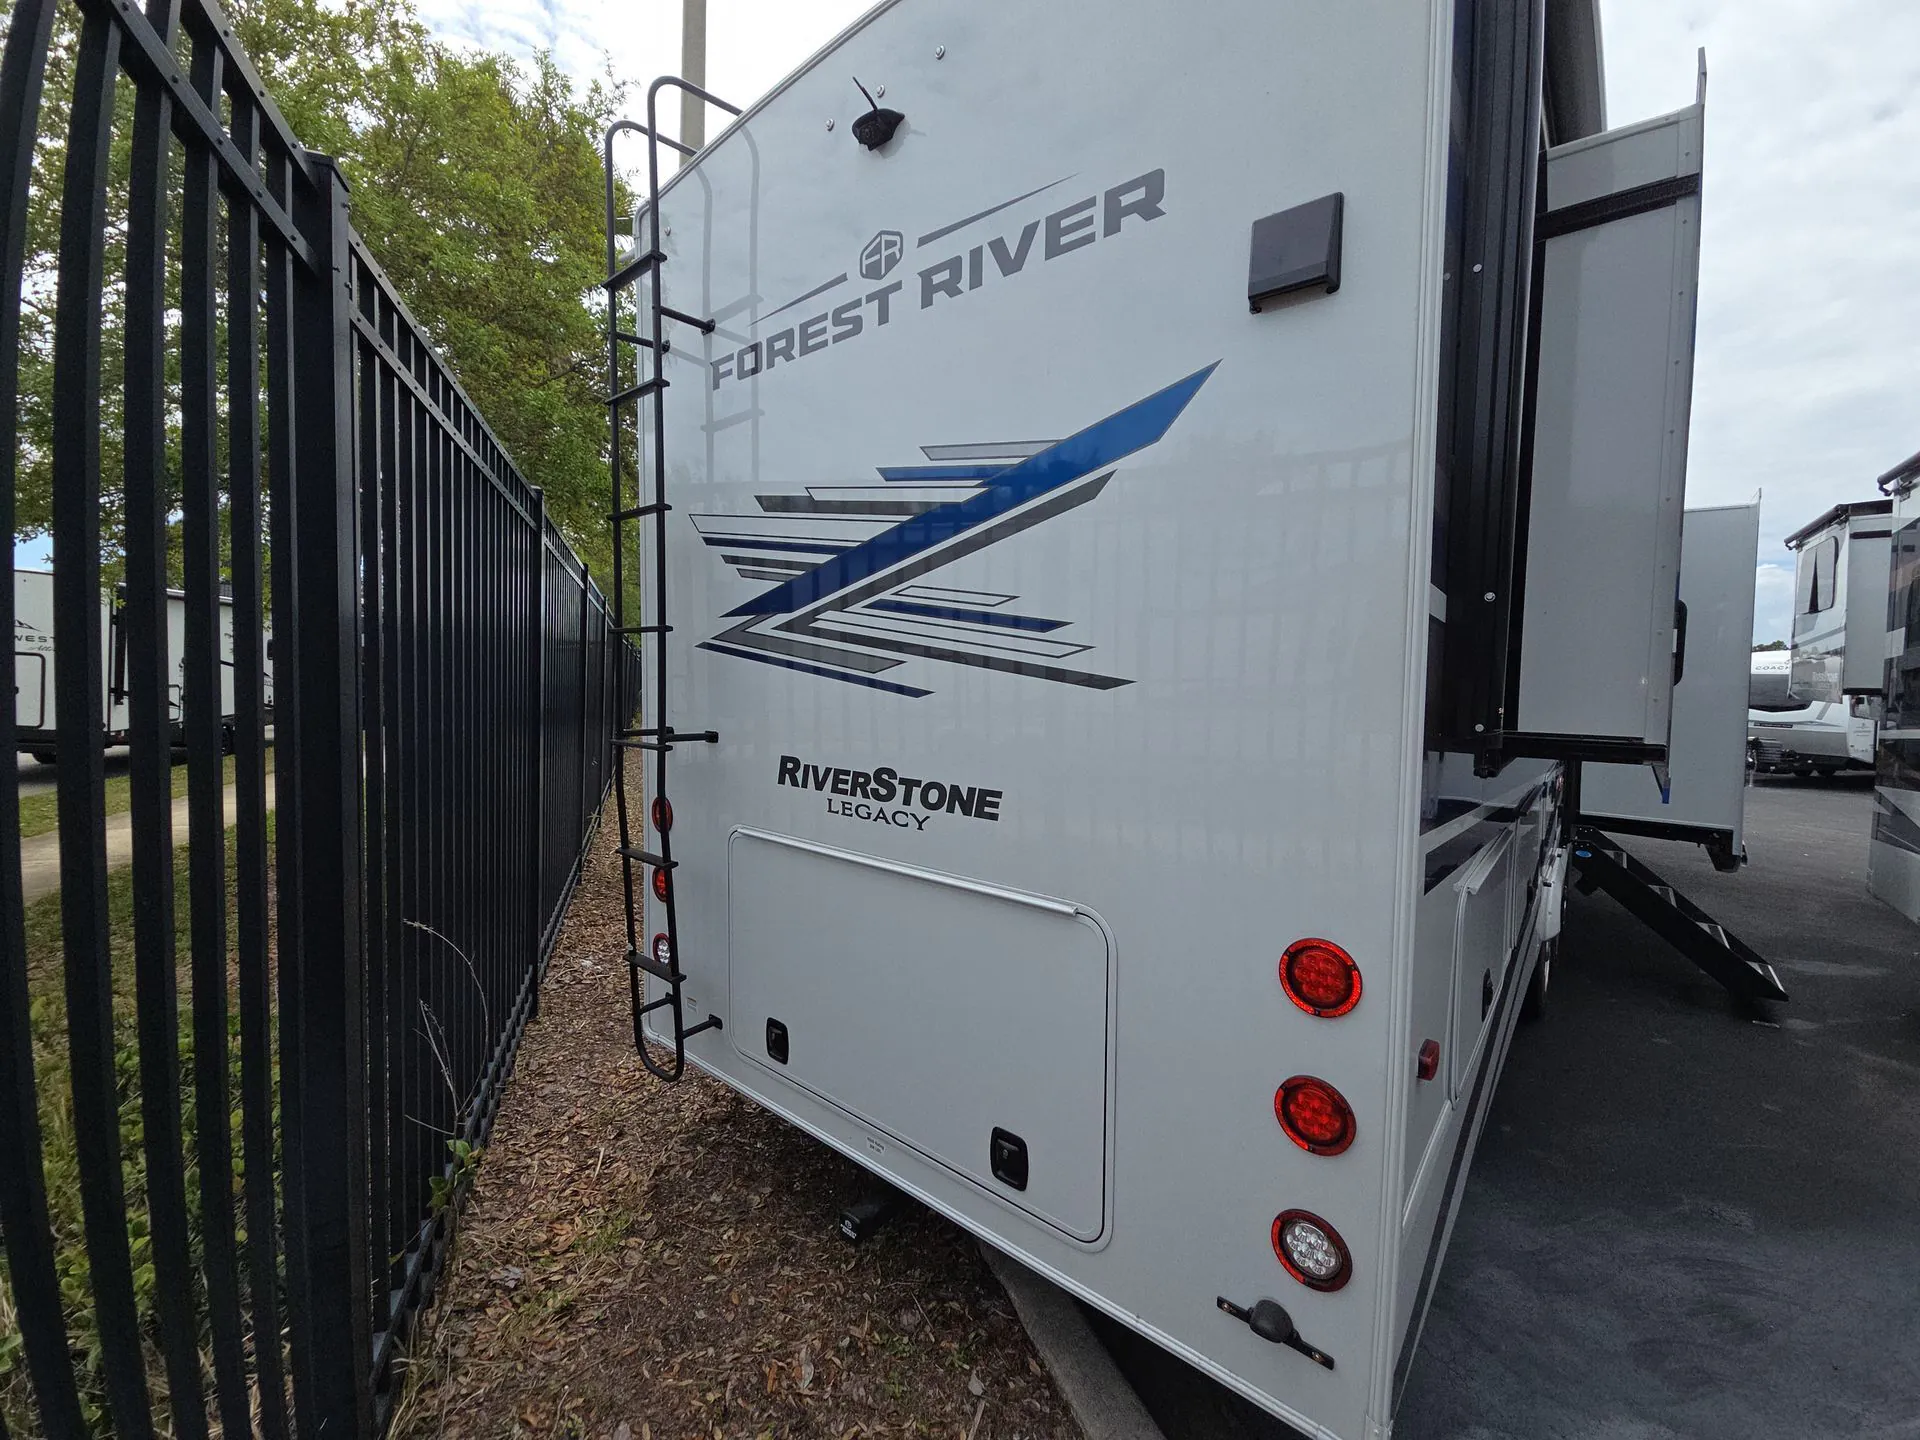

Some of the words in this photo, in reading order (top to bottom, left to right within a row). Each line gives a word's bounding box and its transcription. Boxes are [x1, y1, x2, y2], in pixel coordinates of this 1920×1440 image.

[711, 279, 903, 391] FOREST
[916, 167, 1167, 310] RIVER
[777, 754, 1003, 822] RIVERSTONE
[826, 797, 931, 831] LEGACY
